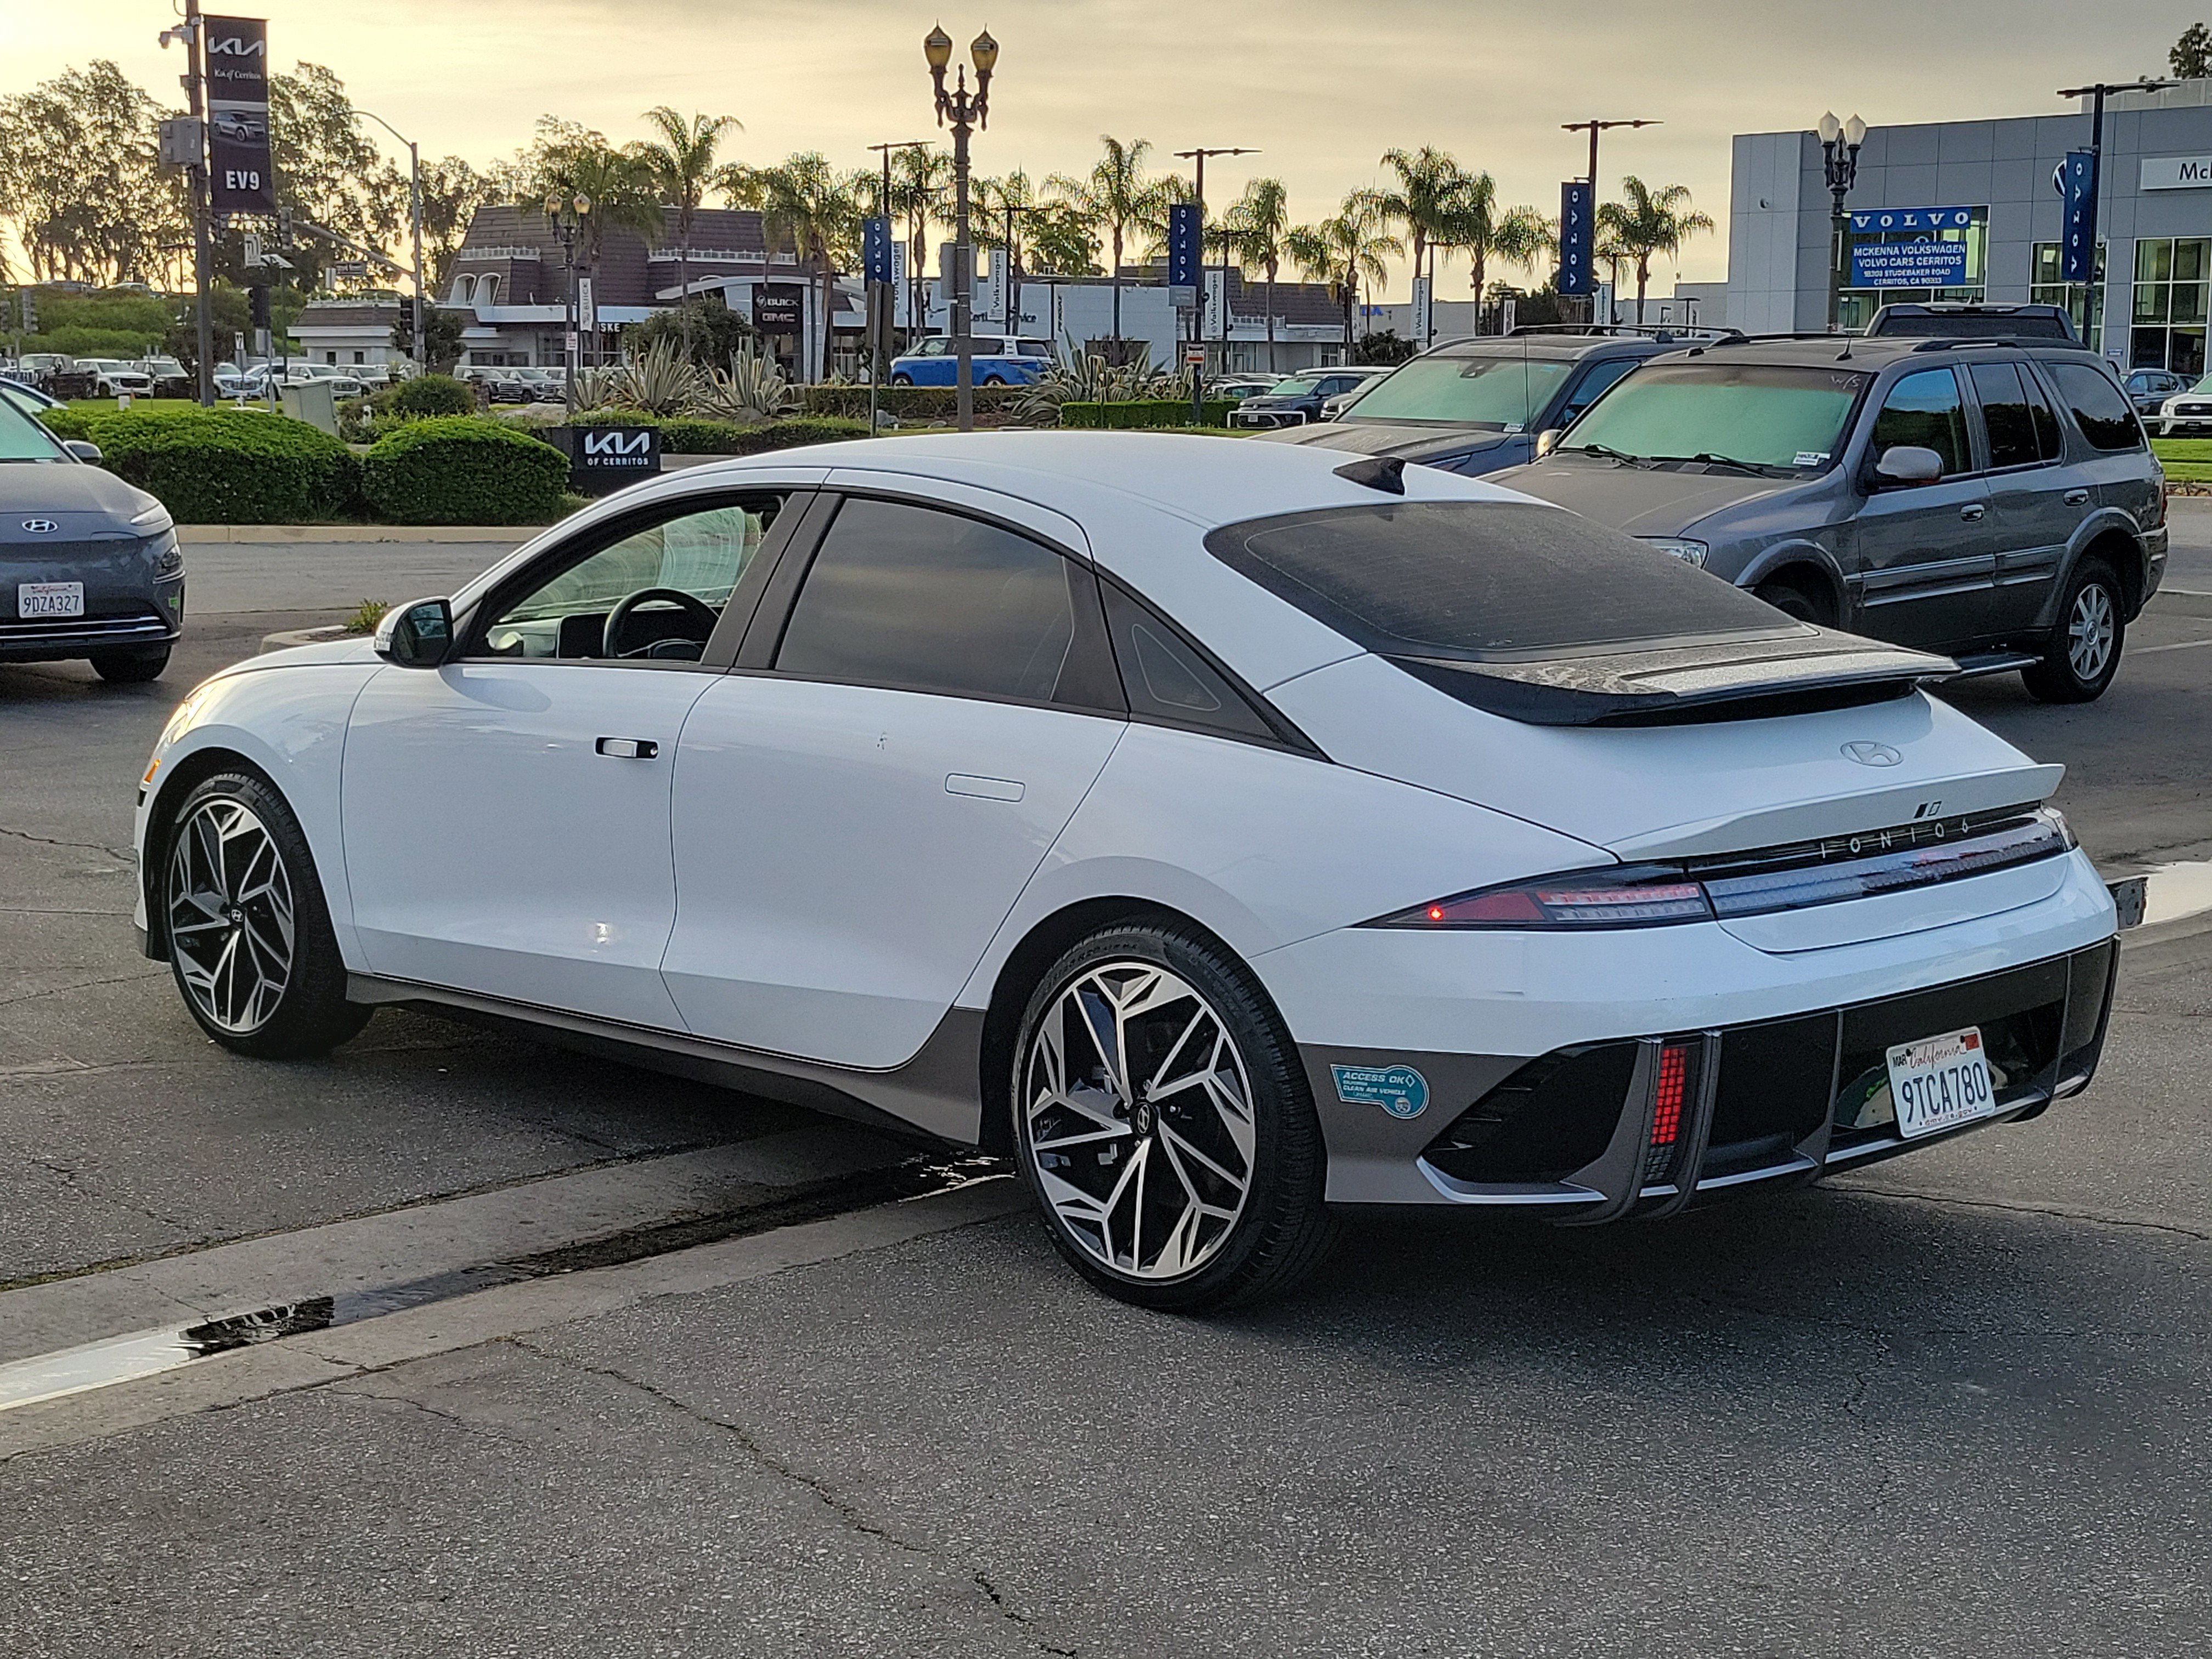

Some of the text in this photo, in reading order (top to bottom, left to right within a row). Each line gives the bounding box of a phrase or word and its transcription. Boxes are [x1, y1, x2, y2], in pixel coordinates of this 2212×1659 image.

[208, 37, 265, 57] KIA
[2179, 162, 2212, 180] Mc
[225, 170, 260, 190] EV9
[1853, 212, 1969, 228] VOLVO
[2071, 162, 2083, 273] VOLVO
[1570, 190, 1578, 288] VOLVO
[1854, 244, 1966, 256] MCKENNA VOLKSWAGEN
[1859, 255, 1962, 267] VOLVO CARS CERRITOS
[767, 298, 799, 307] BUICK
[1415, 280, 1424, 329] Volkswagen
[762, 313, 795, 323] GMC
[585, 432, 650, 454] KIA
[587, 458, 600, 466] OF
[24, 595, 80, 613] 9DZA327
[1961, 818, 1969, 833] 6
[1893, 1053, 1908, 1068] MAR
[1909, 1043, 1968, 1070] California
[1342, 1072, 1405, 1085] ACCESS OK
[1379, 1088, 1407, 1096] VEHICLE
[1901, 1062, 1988, 1124] 9TCA780
